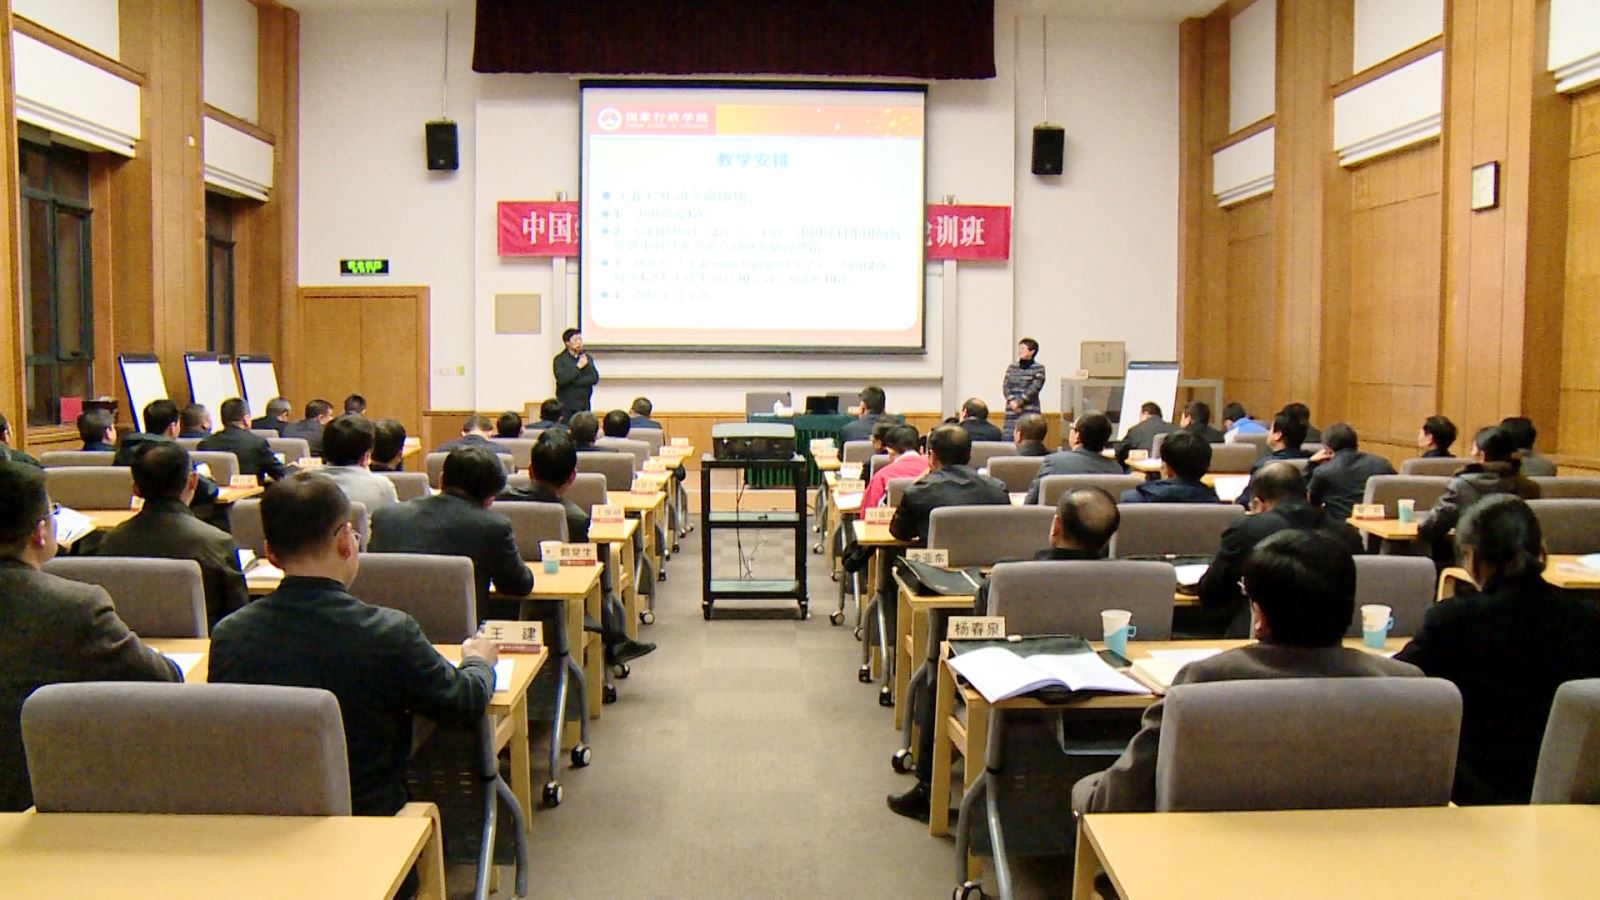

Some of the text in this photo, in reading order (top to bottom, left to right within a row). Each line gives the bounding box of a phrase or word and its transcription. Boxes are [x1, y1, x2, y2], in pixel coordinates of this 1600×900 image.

[717, 152, 791, 169] 教学安排
[522, 210, 578, 245] 中国
[954, 621, 1000, 637] 杨春泉
